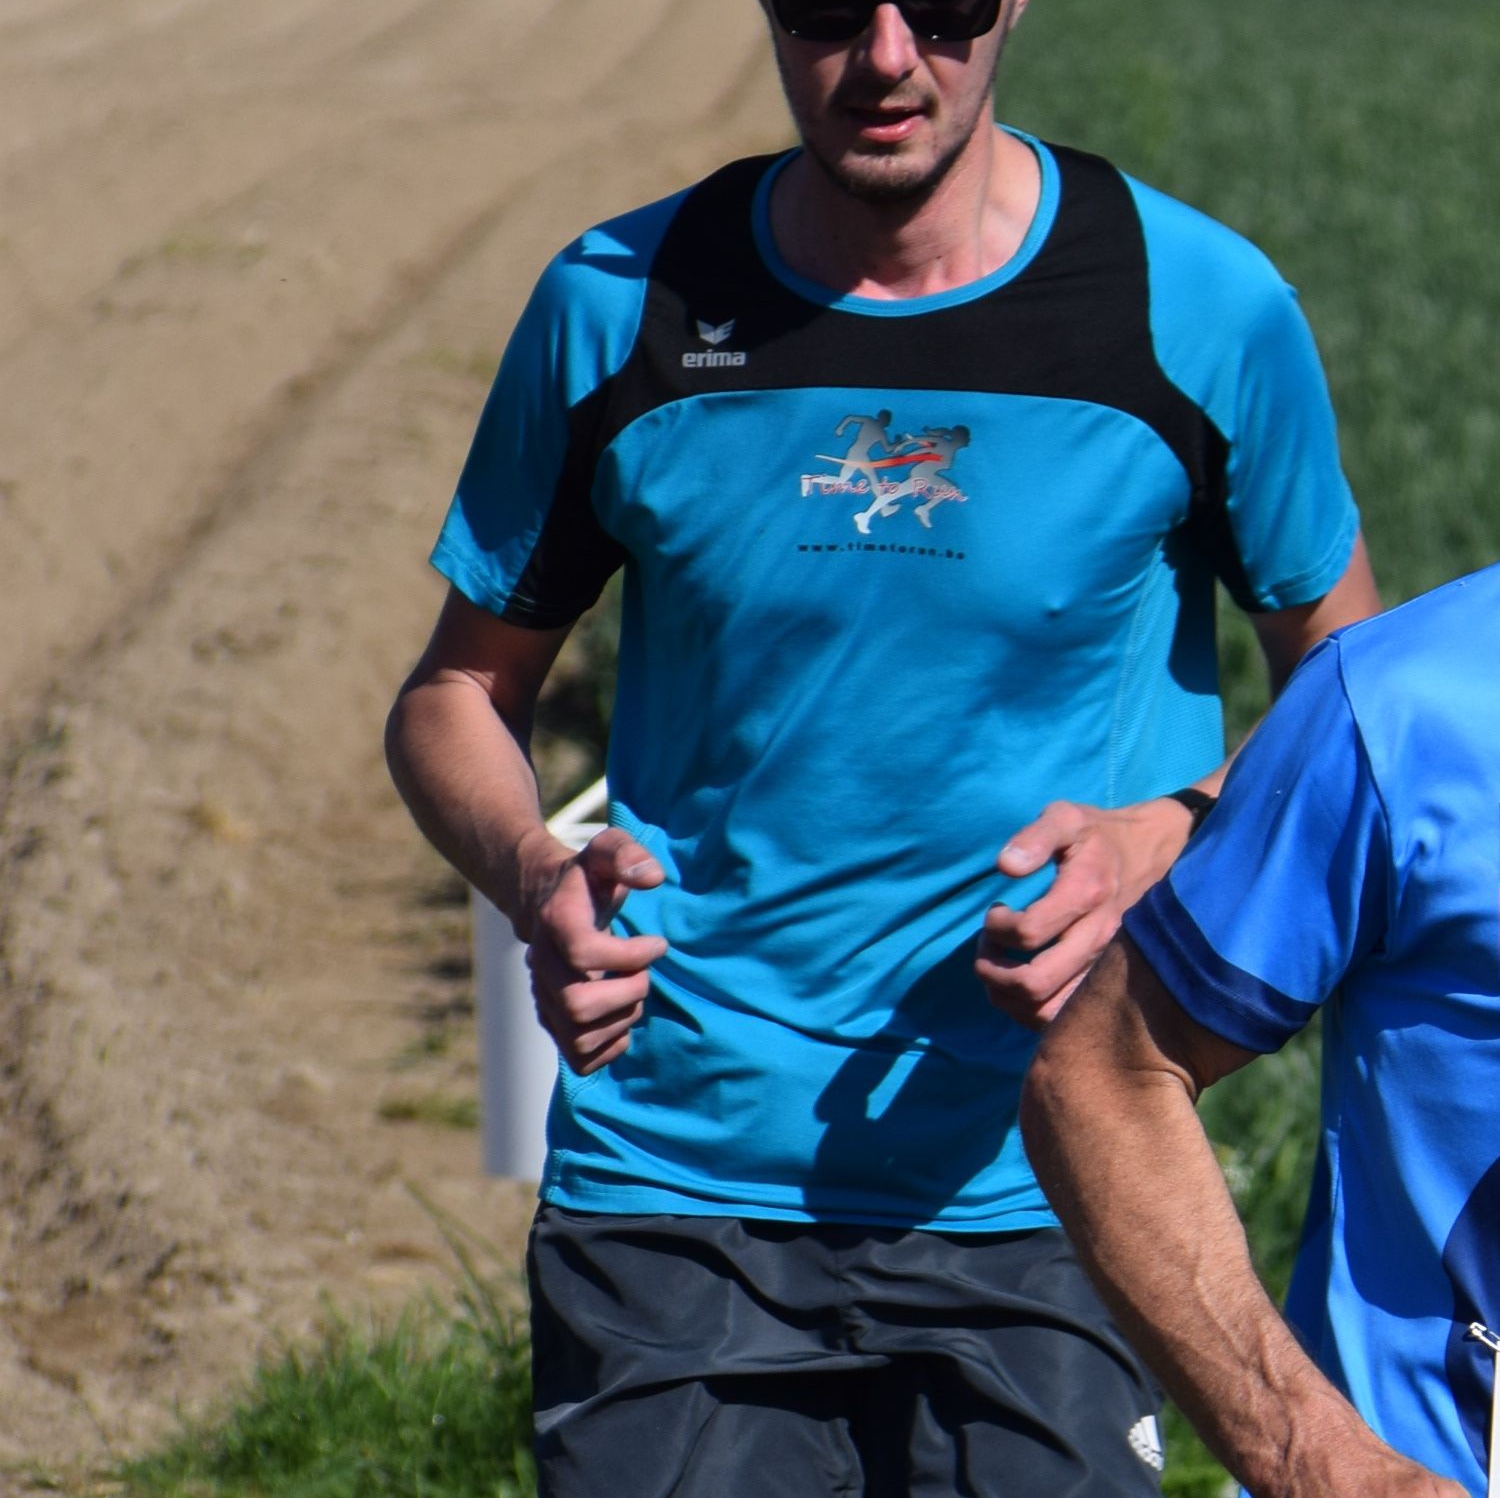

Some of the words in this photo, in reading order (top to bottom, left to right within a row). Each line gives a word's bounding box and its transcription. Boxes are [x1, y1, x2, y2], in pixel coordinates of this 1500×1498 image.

[682, 350, 746, 368] erima
[800, 474, 870, 496] Time
[877, 476, 901, 496] to
[911, 477, 970, 502] Run
